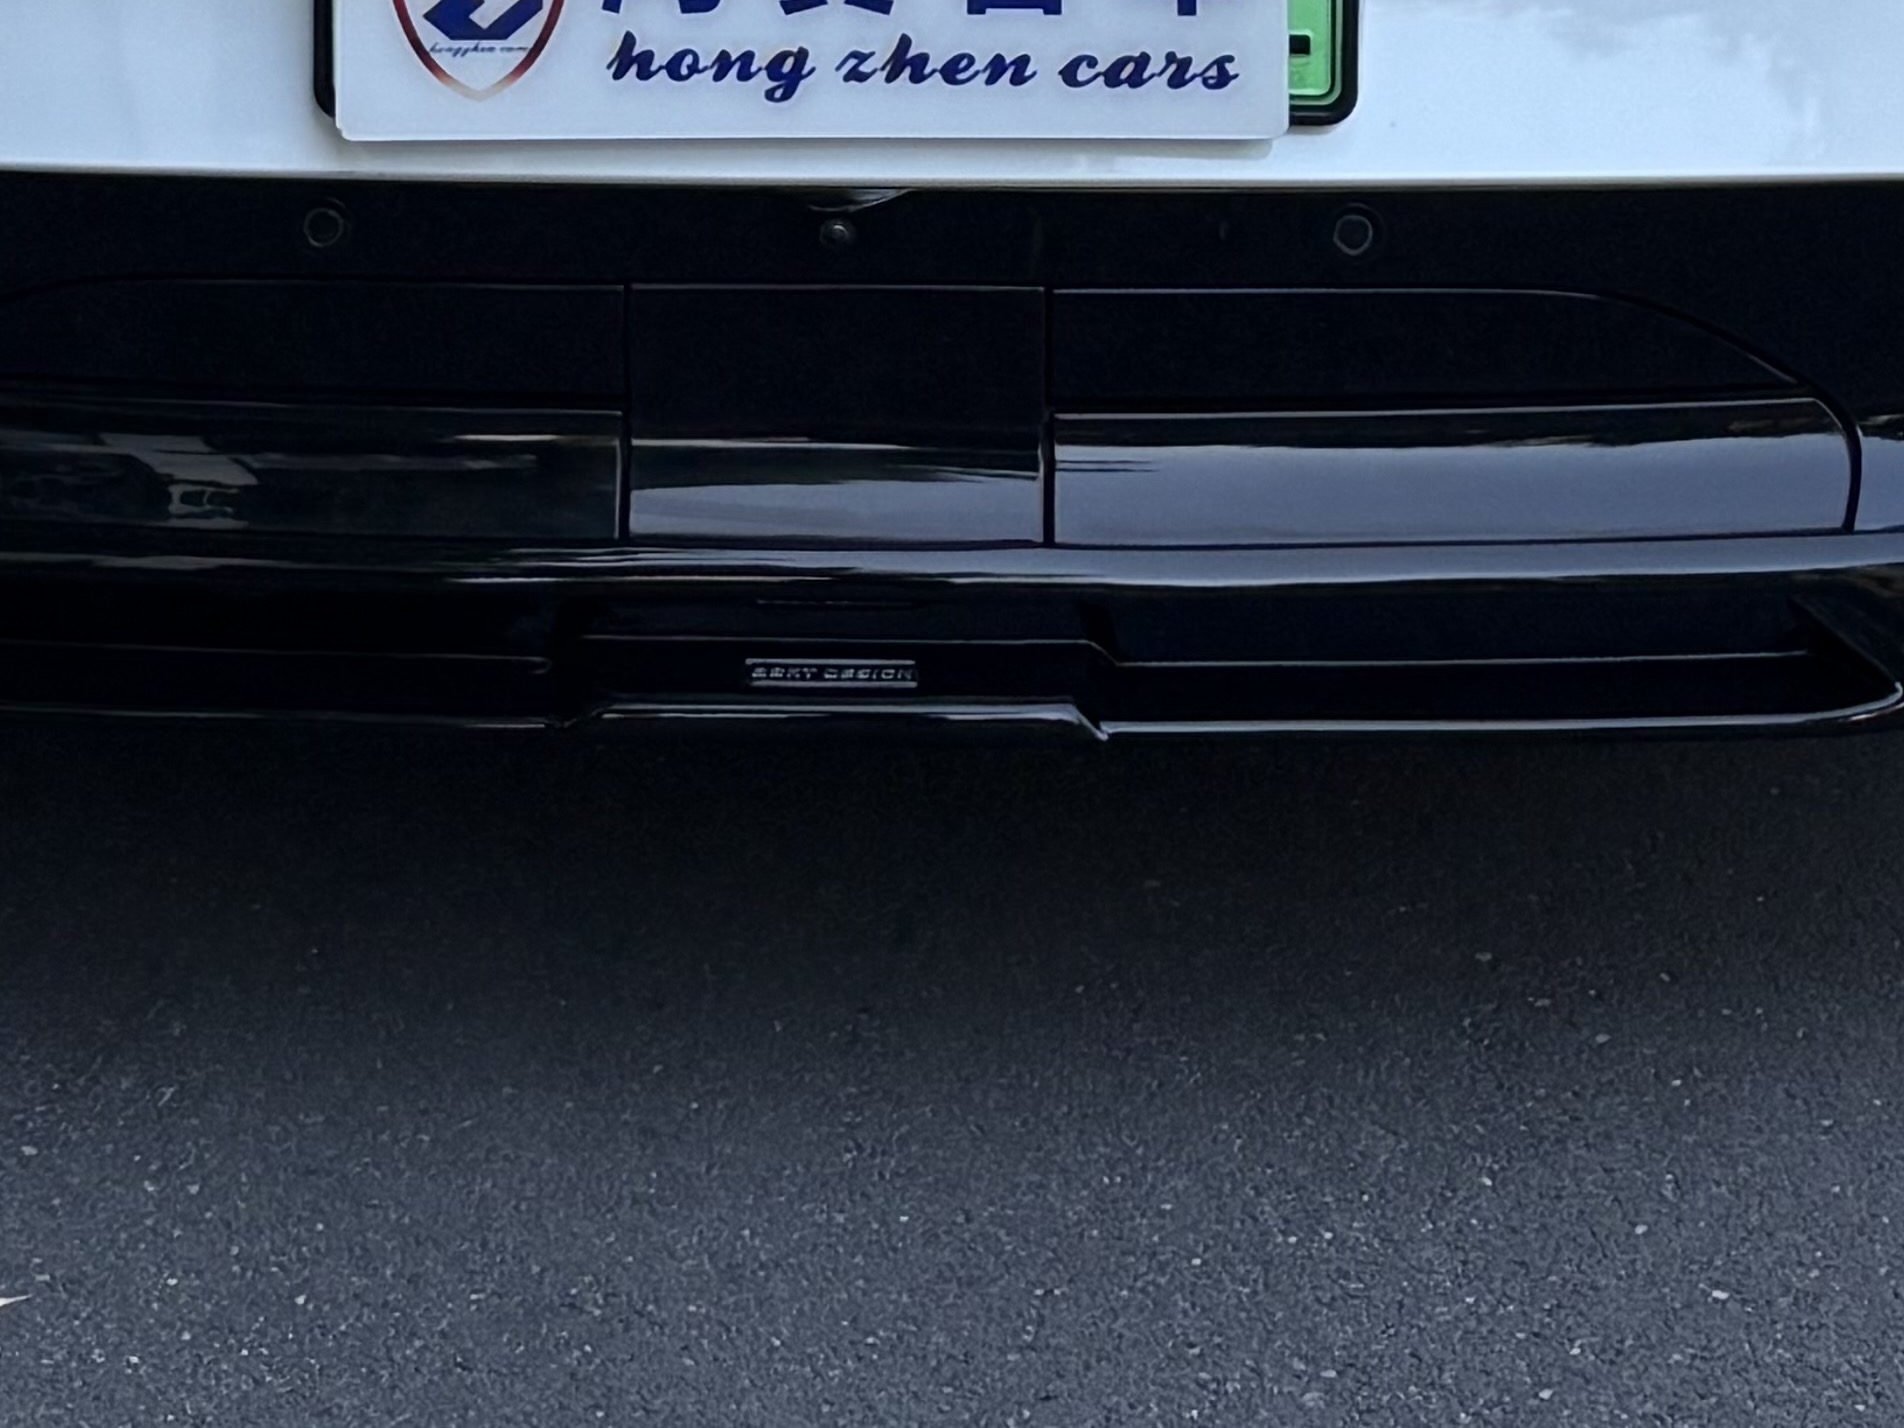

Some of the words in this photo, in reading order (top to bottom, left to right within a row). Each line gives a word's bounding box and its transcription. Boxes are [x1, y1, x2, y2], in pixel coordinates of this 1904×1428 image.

[607, 30, 816, 103] hong
[835, 33, 1038, 88] zhen
[1057, 50, 1240, 90] cars
